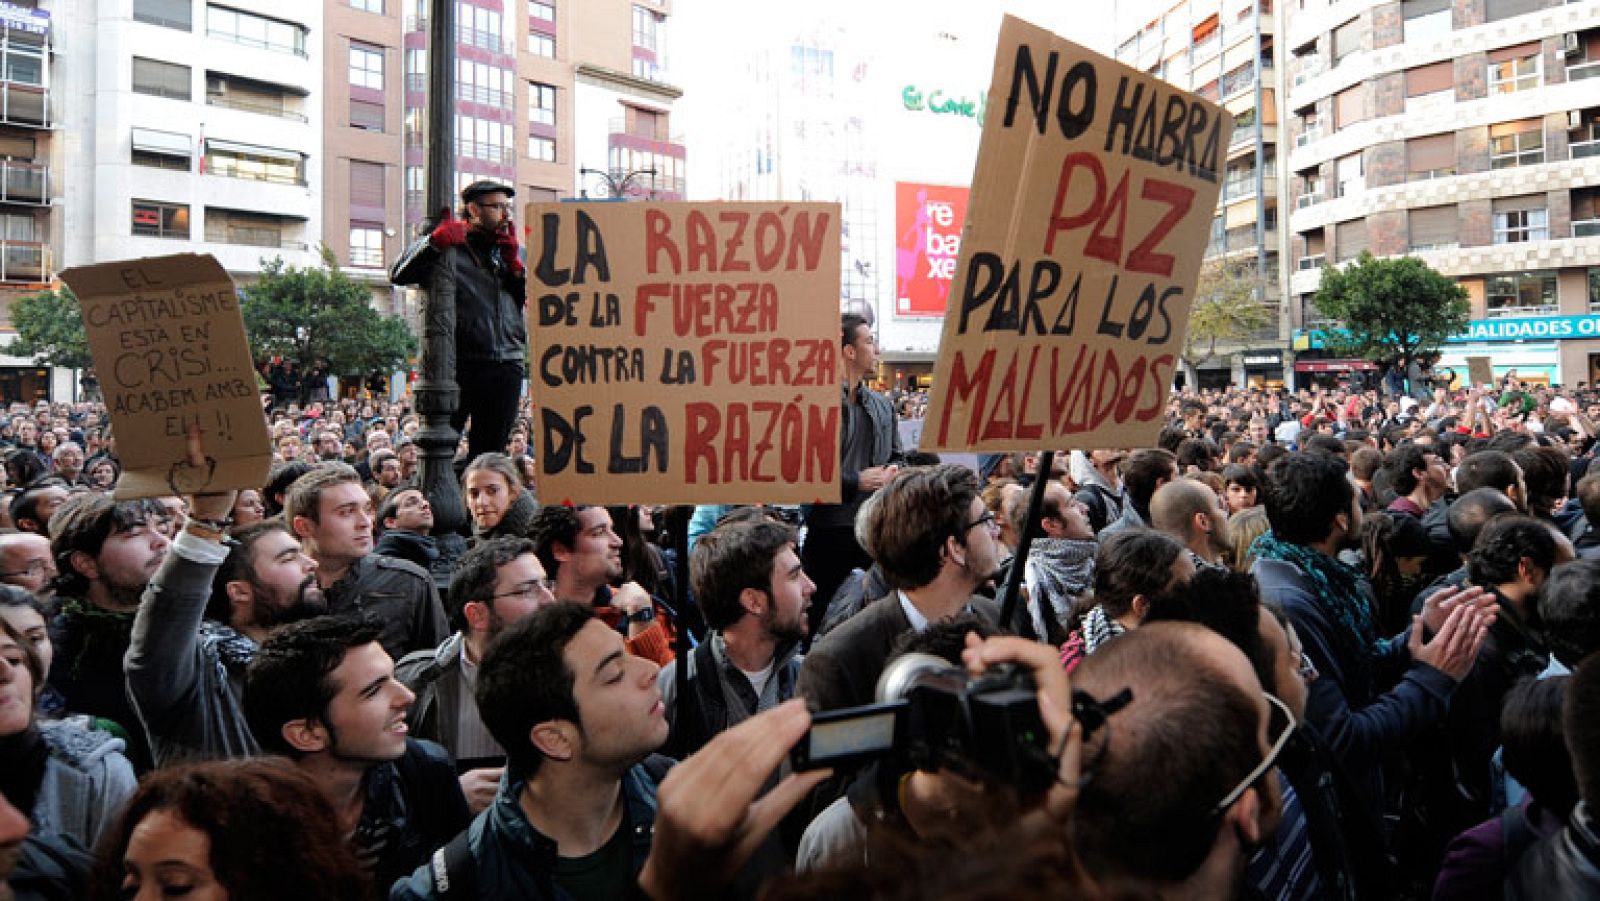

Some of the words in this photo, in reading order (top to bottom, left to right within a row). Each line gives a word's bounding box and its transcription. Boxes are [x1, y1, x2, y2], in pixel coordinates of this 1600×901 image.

[1003, 44, 1098, 140] NO
[1104, 75, 1223, 184] HABRA
[926, 202, 953, 226] re
[1043, 151, 1196, 277] PAZ
[535, 210, 610, 286] LA
[645, 206, 830, 275] RAZÓN
[926, 227, 962, 255] ba
[120, 268, 162, 289] EL
[958, 252, 1083, 336] PARA
[1098, 274, 1184, 345] LOS
[181, 321, 211, 344] EN
[538, 292, 580, 326] DE
[590, 292, 621, 327] LA
[634, 283, 779, 337] FUERZA
[1448, 318, 1572, 339] IALIDADES
[539, 344, 645, 386] CONTRA
[660, 348, 696, 384] LA
[701, 338, 836, 386] FUERZA
[114, 388, 195, 416] ACABEM
[206, 378, 251, 400] AMB
[937, 343, 1174, 448] MALVADOS
[541, 405, 596, 475] DE
[607, 403, 669, 474] LA
[684, 394, 838, 484] RAZÓN
